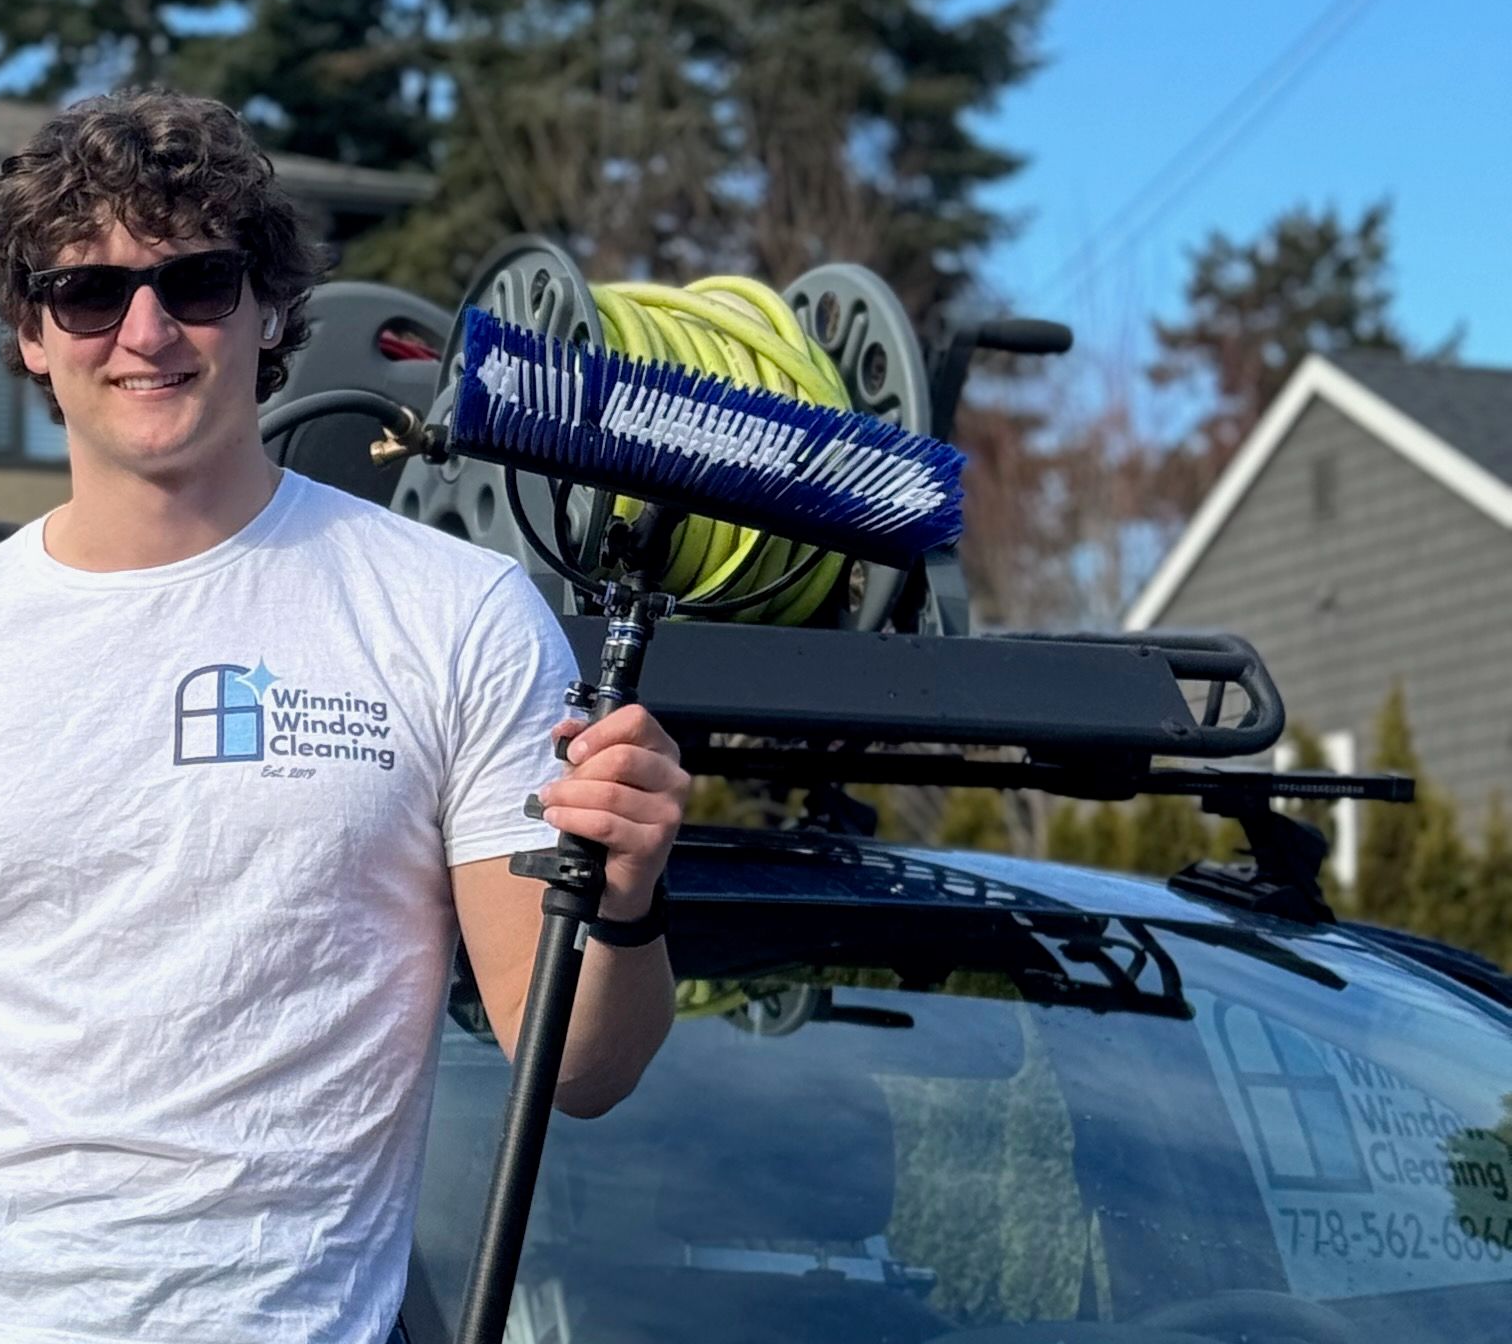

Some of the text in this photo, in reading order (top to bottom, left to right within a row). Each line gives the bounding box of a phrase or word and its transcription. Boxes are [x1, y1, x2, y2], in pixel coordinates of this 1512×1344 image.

[272, 689, 387, 721] Winning
[271, 711, 391, 739] Window
[269, 735, 395, 770] Cleaning
[1368, 1140, 1509, 1201] Cleaning
